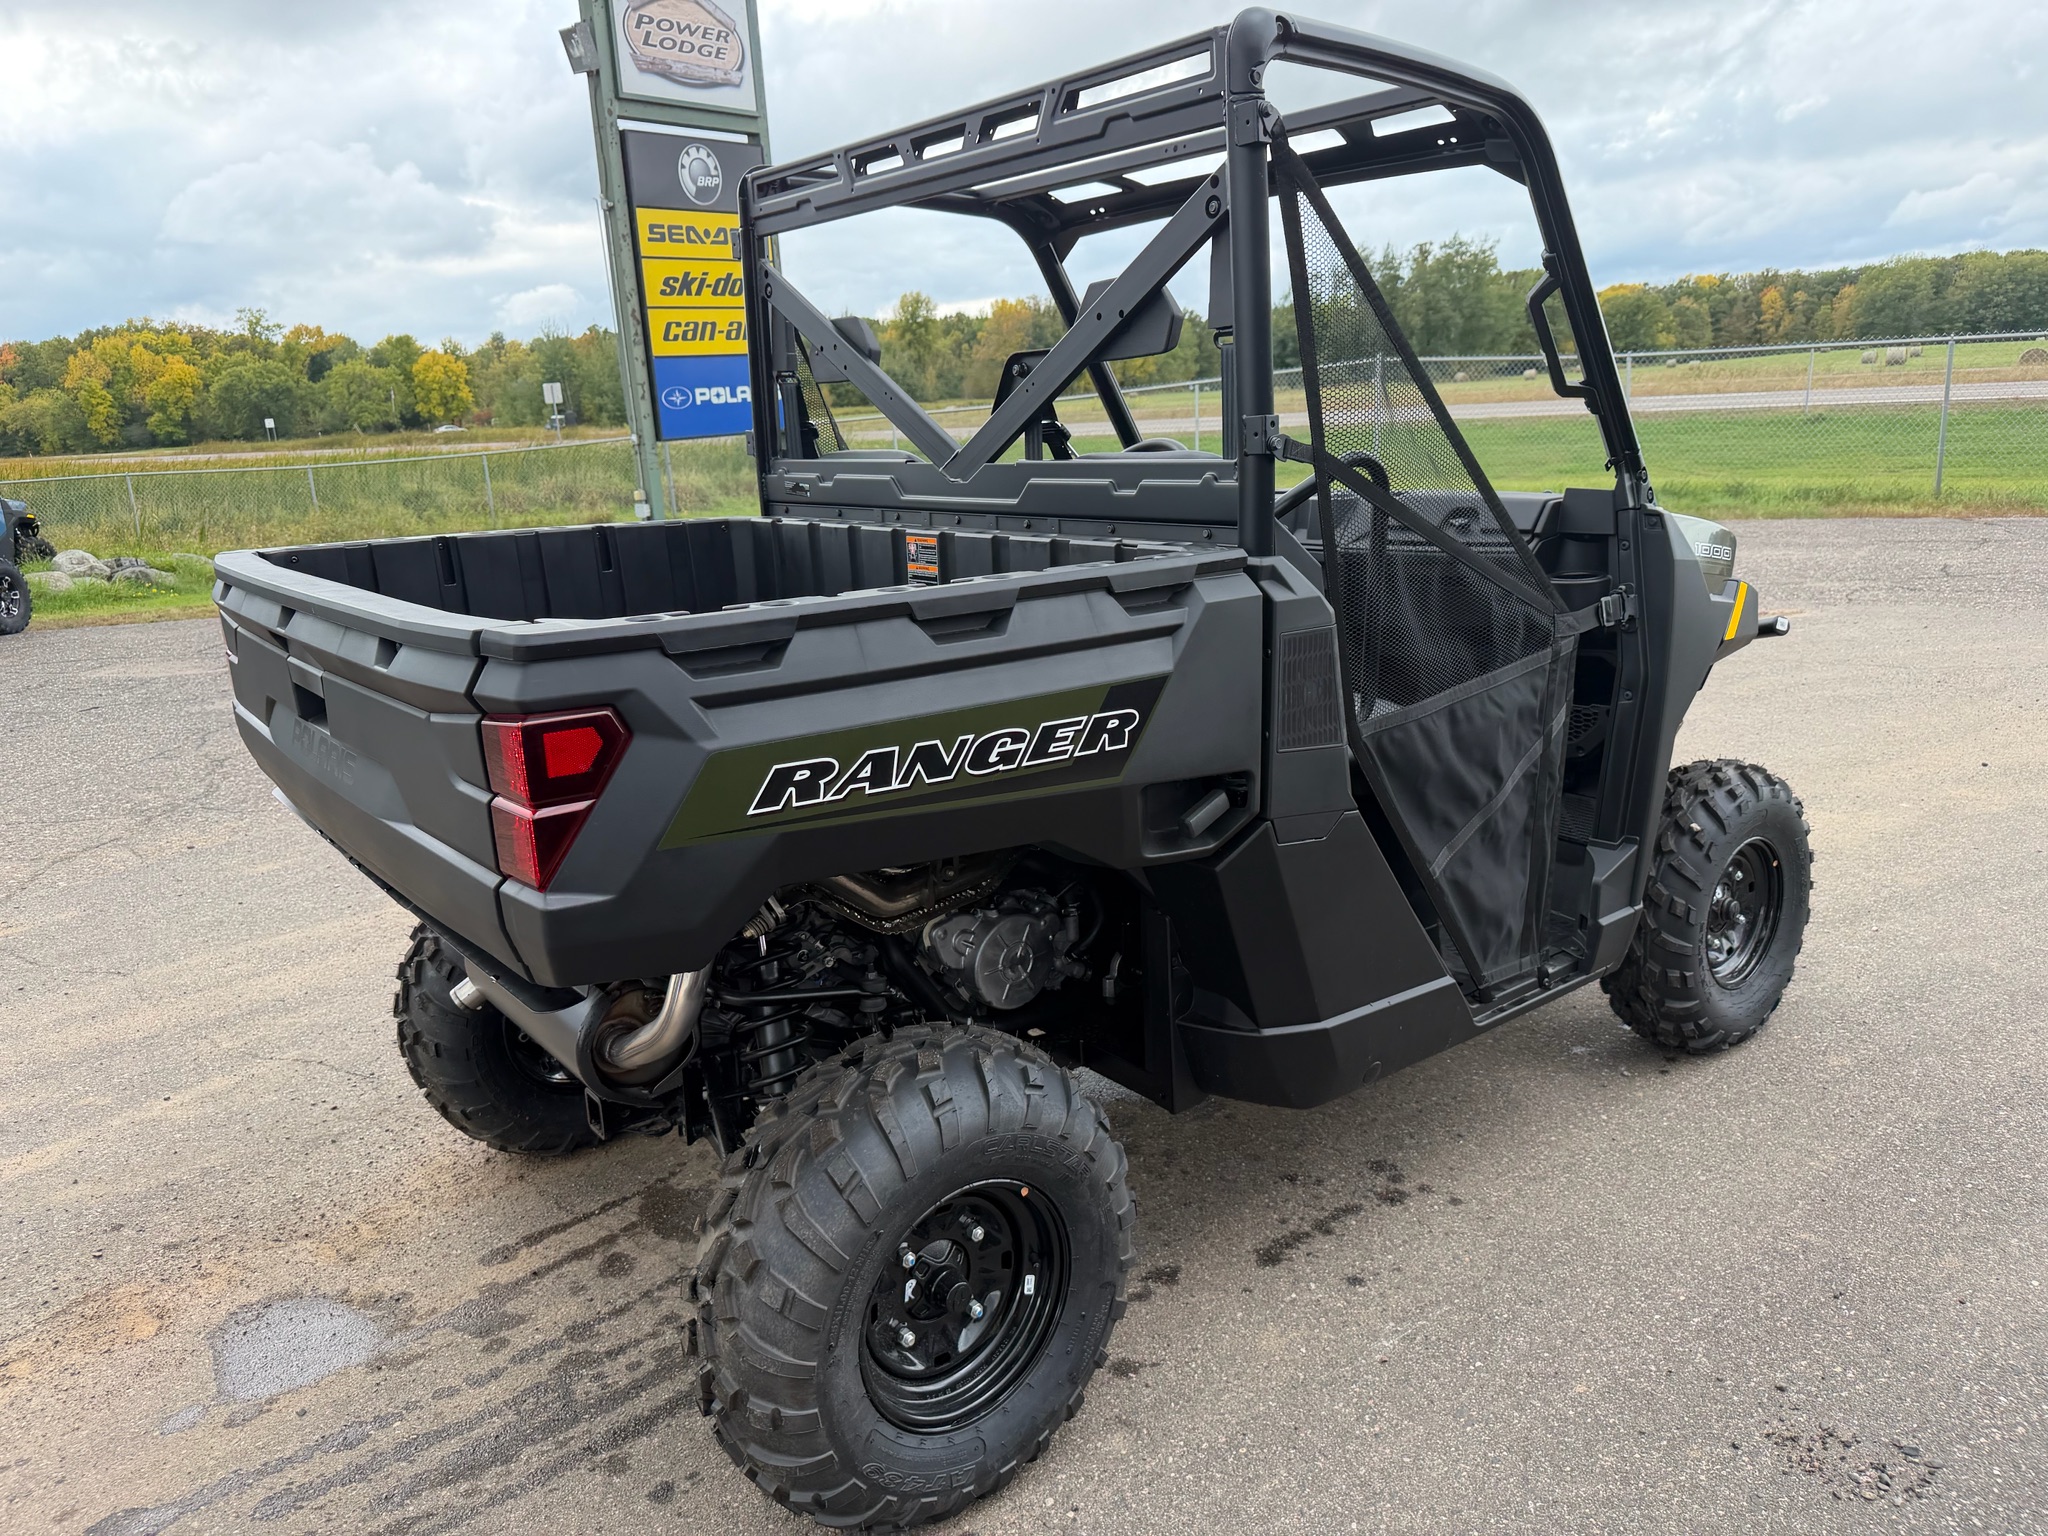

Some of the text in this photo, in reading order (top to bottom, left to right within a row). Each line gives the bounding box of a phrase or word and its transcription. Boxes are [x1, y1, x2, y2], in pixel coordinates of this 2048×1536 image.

[634, 13, 731, 44] POWER
[641, 30, 729, 61] LODGE
[697, 176, 720, 188] BRP
[662, 321, 747, 342] can-a
[695, 385, 752, 406] POLA
[1694, 542, 1732, 561] 1000
[747, 708, 1140, 816] RANGER
